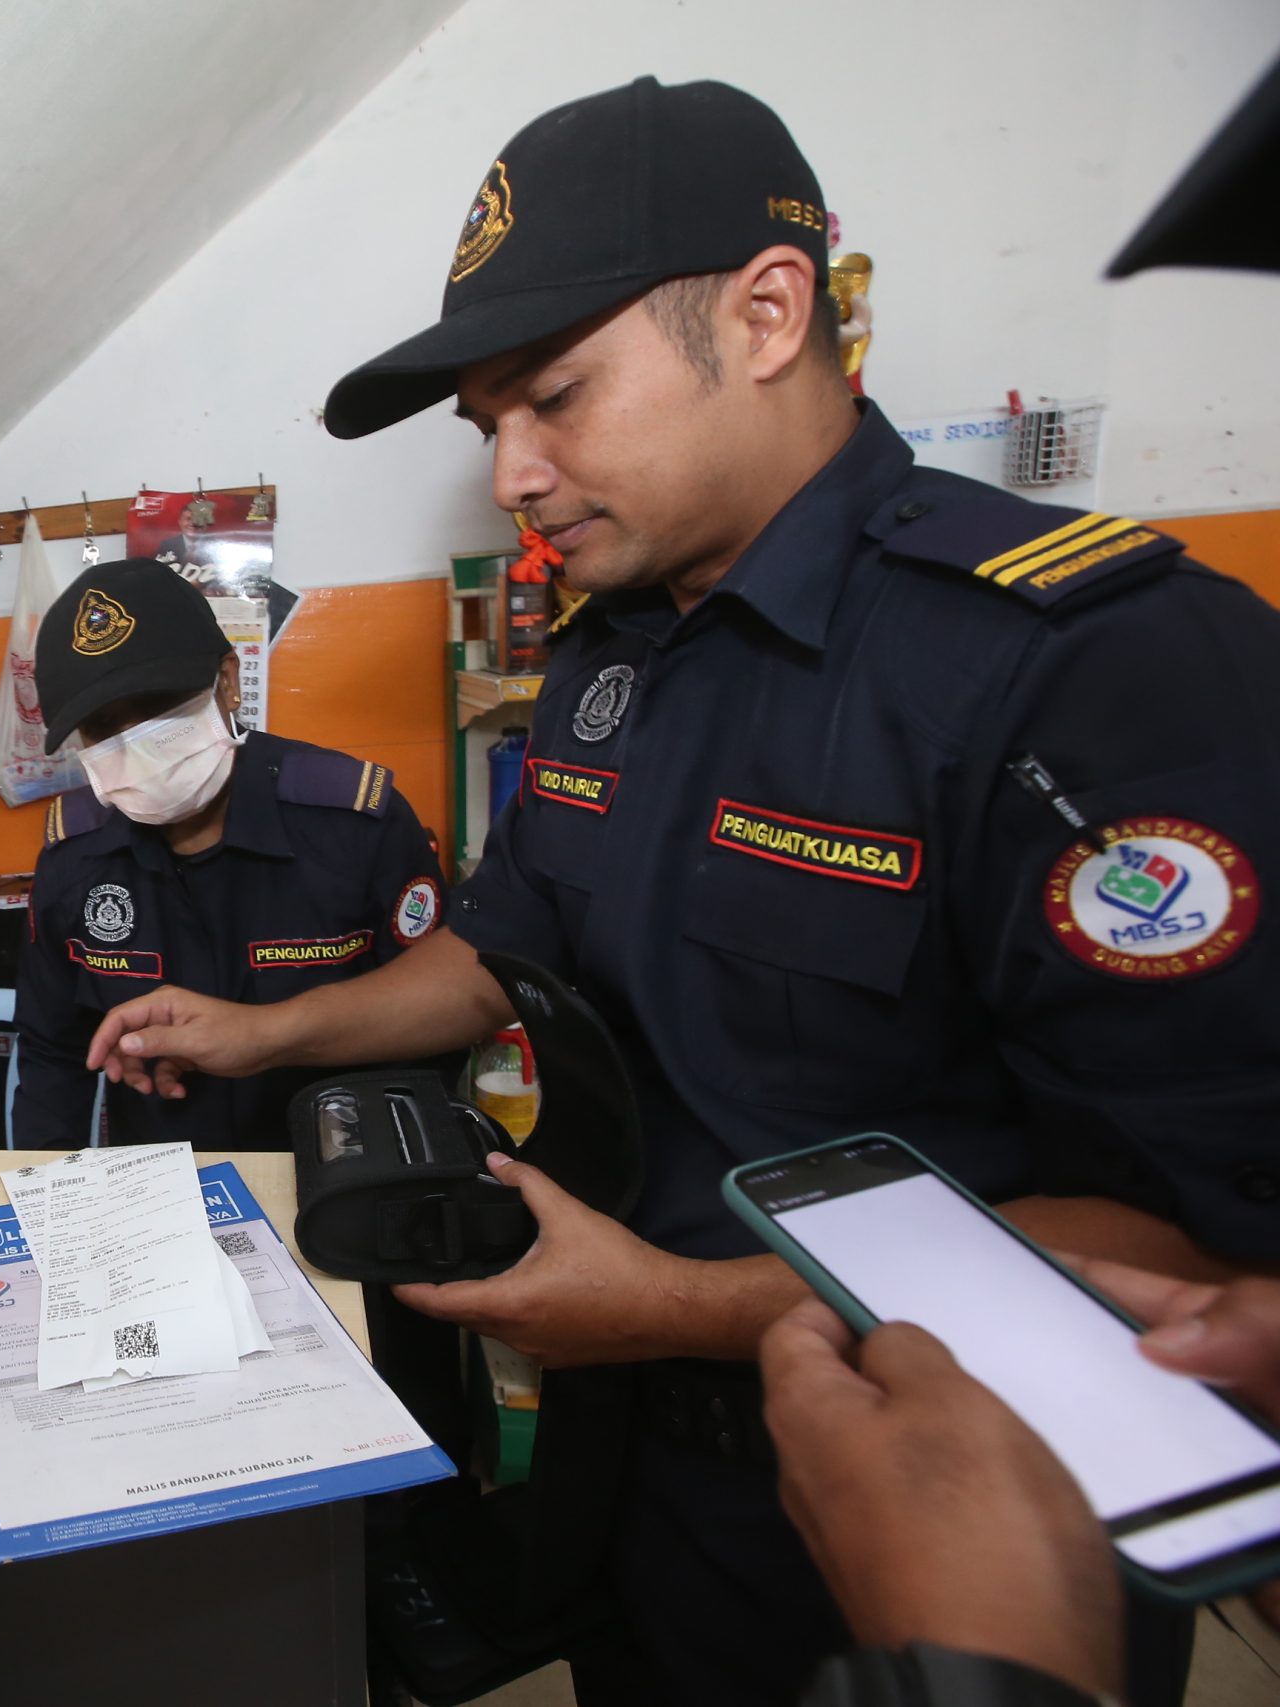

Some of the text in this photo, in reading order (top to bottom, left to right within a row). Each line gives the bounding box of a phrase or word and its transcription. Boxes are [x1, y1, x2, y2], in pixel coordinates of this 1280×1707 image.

[244, 661, 259, 671] 27
[242, 676, 259, 686] 28
[242, 692, 259, 701] 29
[241, 706, 259, 716] 30
[562, 775, 603, 799] FAIRUZ
[720, 813, 902, 875] PENGUATKUASA
[1109, 911, 1206, 946] MBSJ
[256, 937, 365, 961] PENGUATKUASA
[86, 954, 128, 969] SUTHA
[126, 1454, 315, 1495] MAJLIS BANDARAYA SUBANG JAYA
